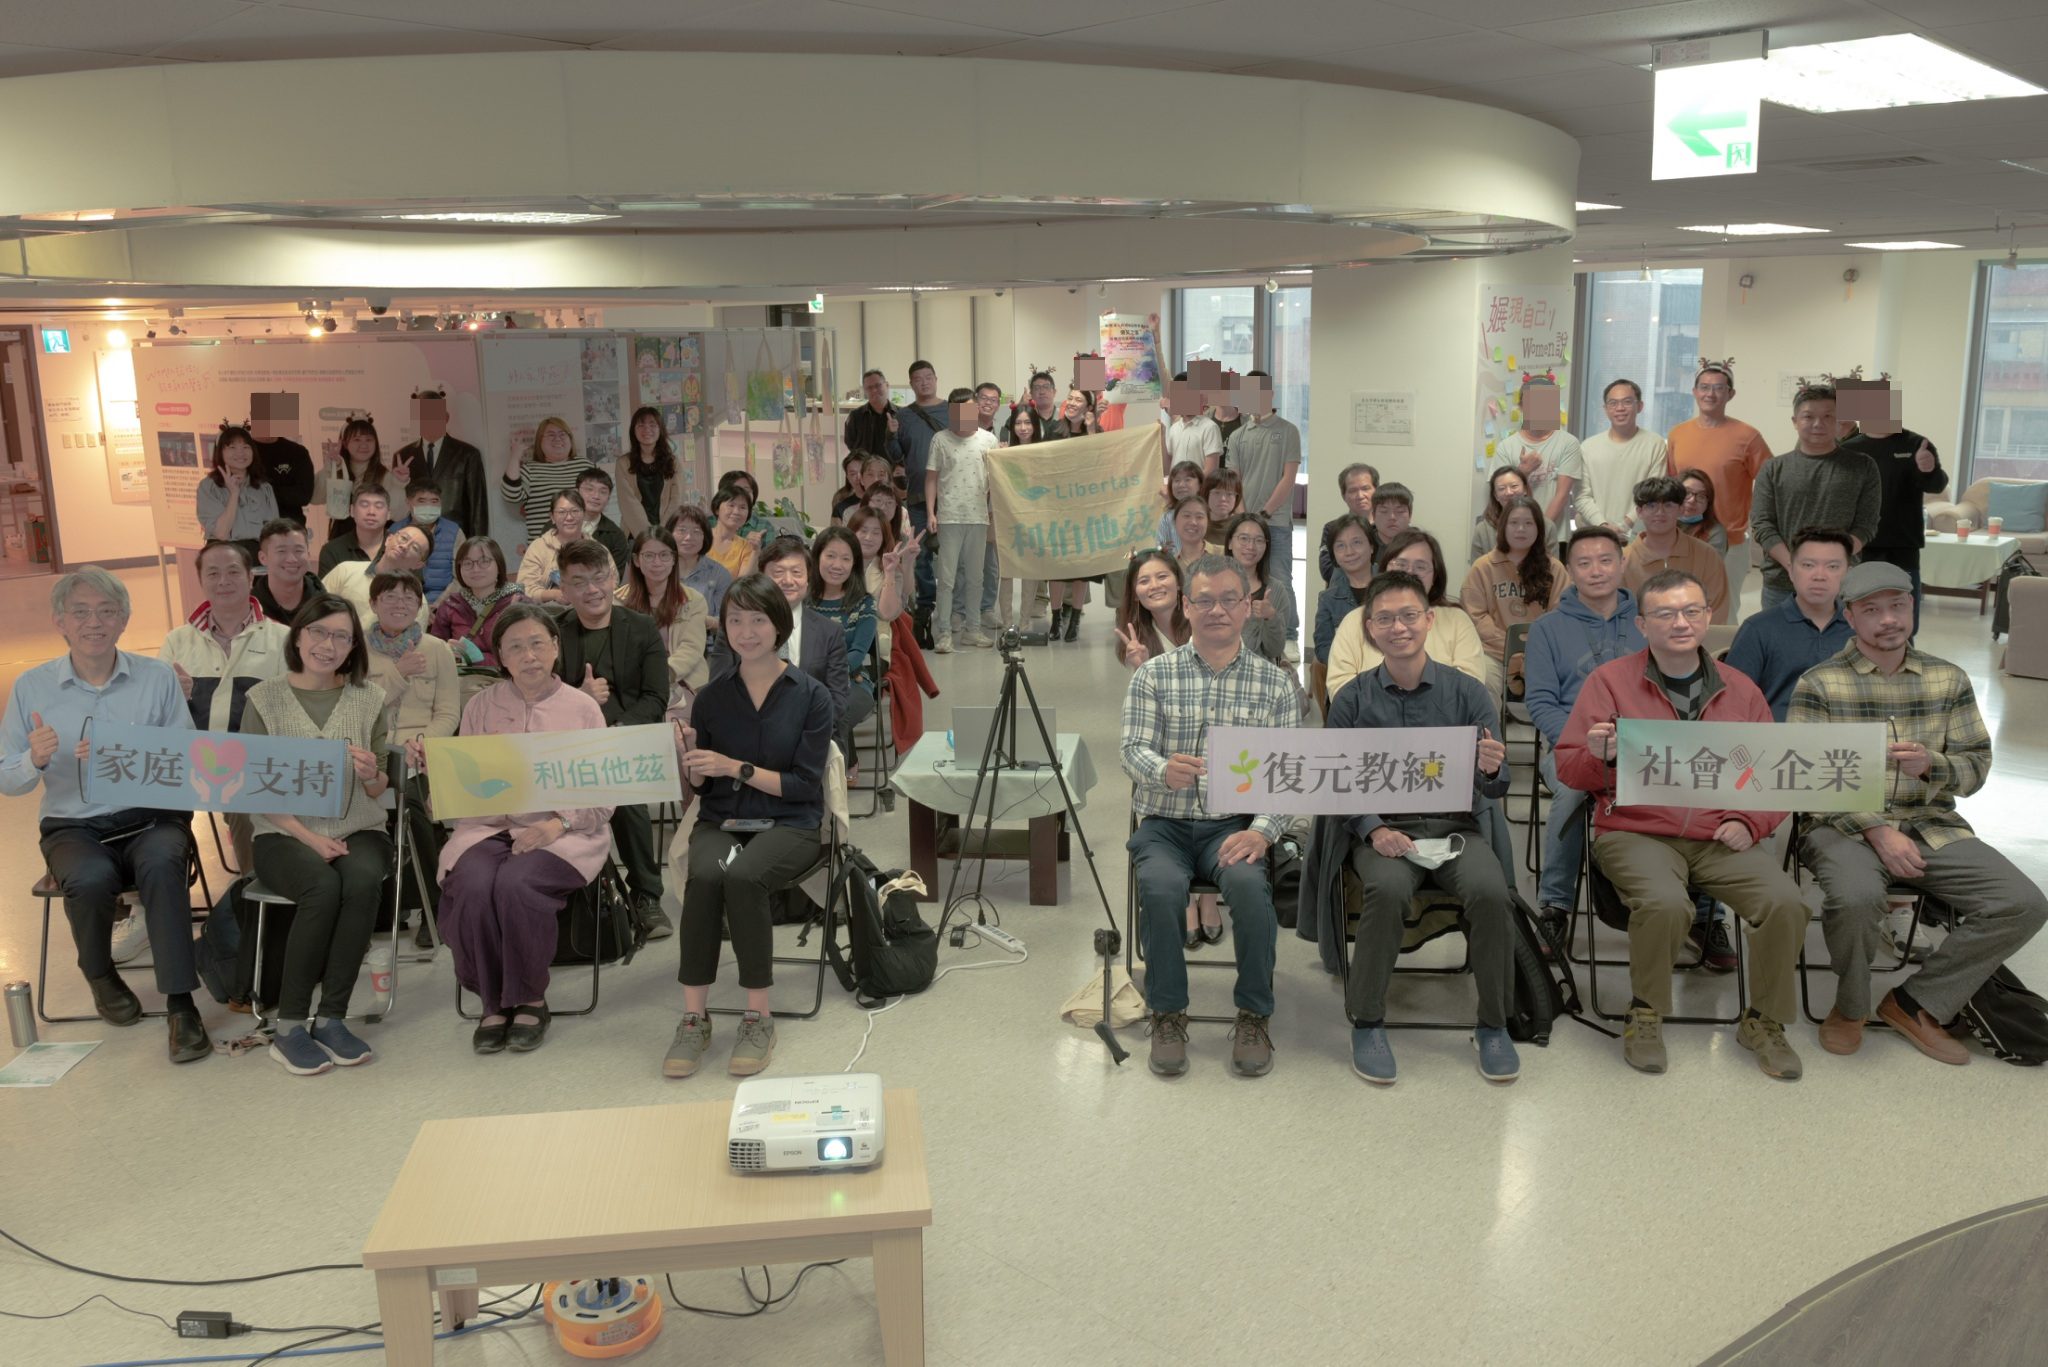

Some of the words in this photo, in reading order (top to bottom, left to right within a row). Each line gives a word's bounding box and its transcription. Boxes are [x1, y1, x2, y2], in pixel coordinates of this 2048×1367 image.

[1055, 474, 1140, 499] Libertas
[1008, 505, 1158, 558] 利伯他茲
[95, 743, 185, 788] 家庭
[246, 757, 334, 798] 支持
[533, 753, 666, 790] 利伯他茲
[1262, 751, 1447, 794] 復元教練
[1636, 745, 1729, 790] 社會
[1770, 748, 1862, 792] 企業
